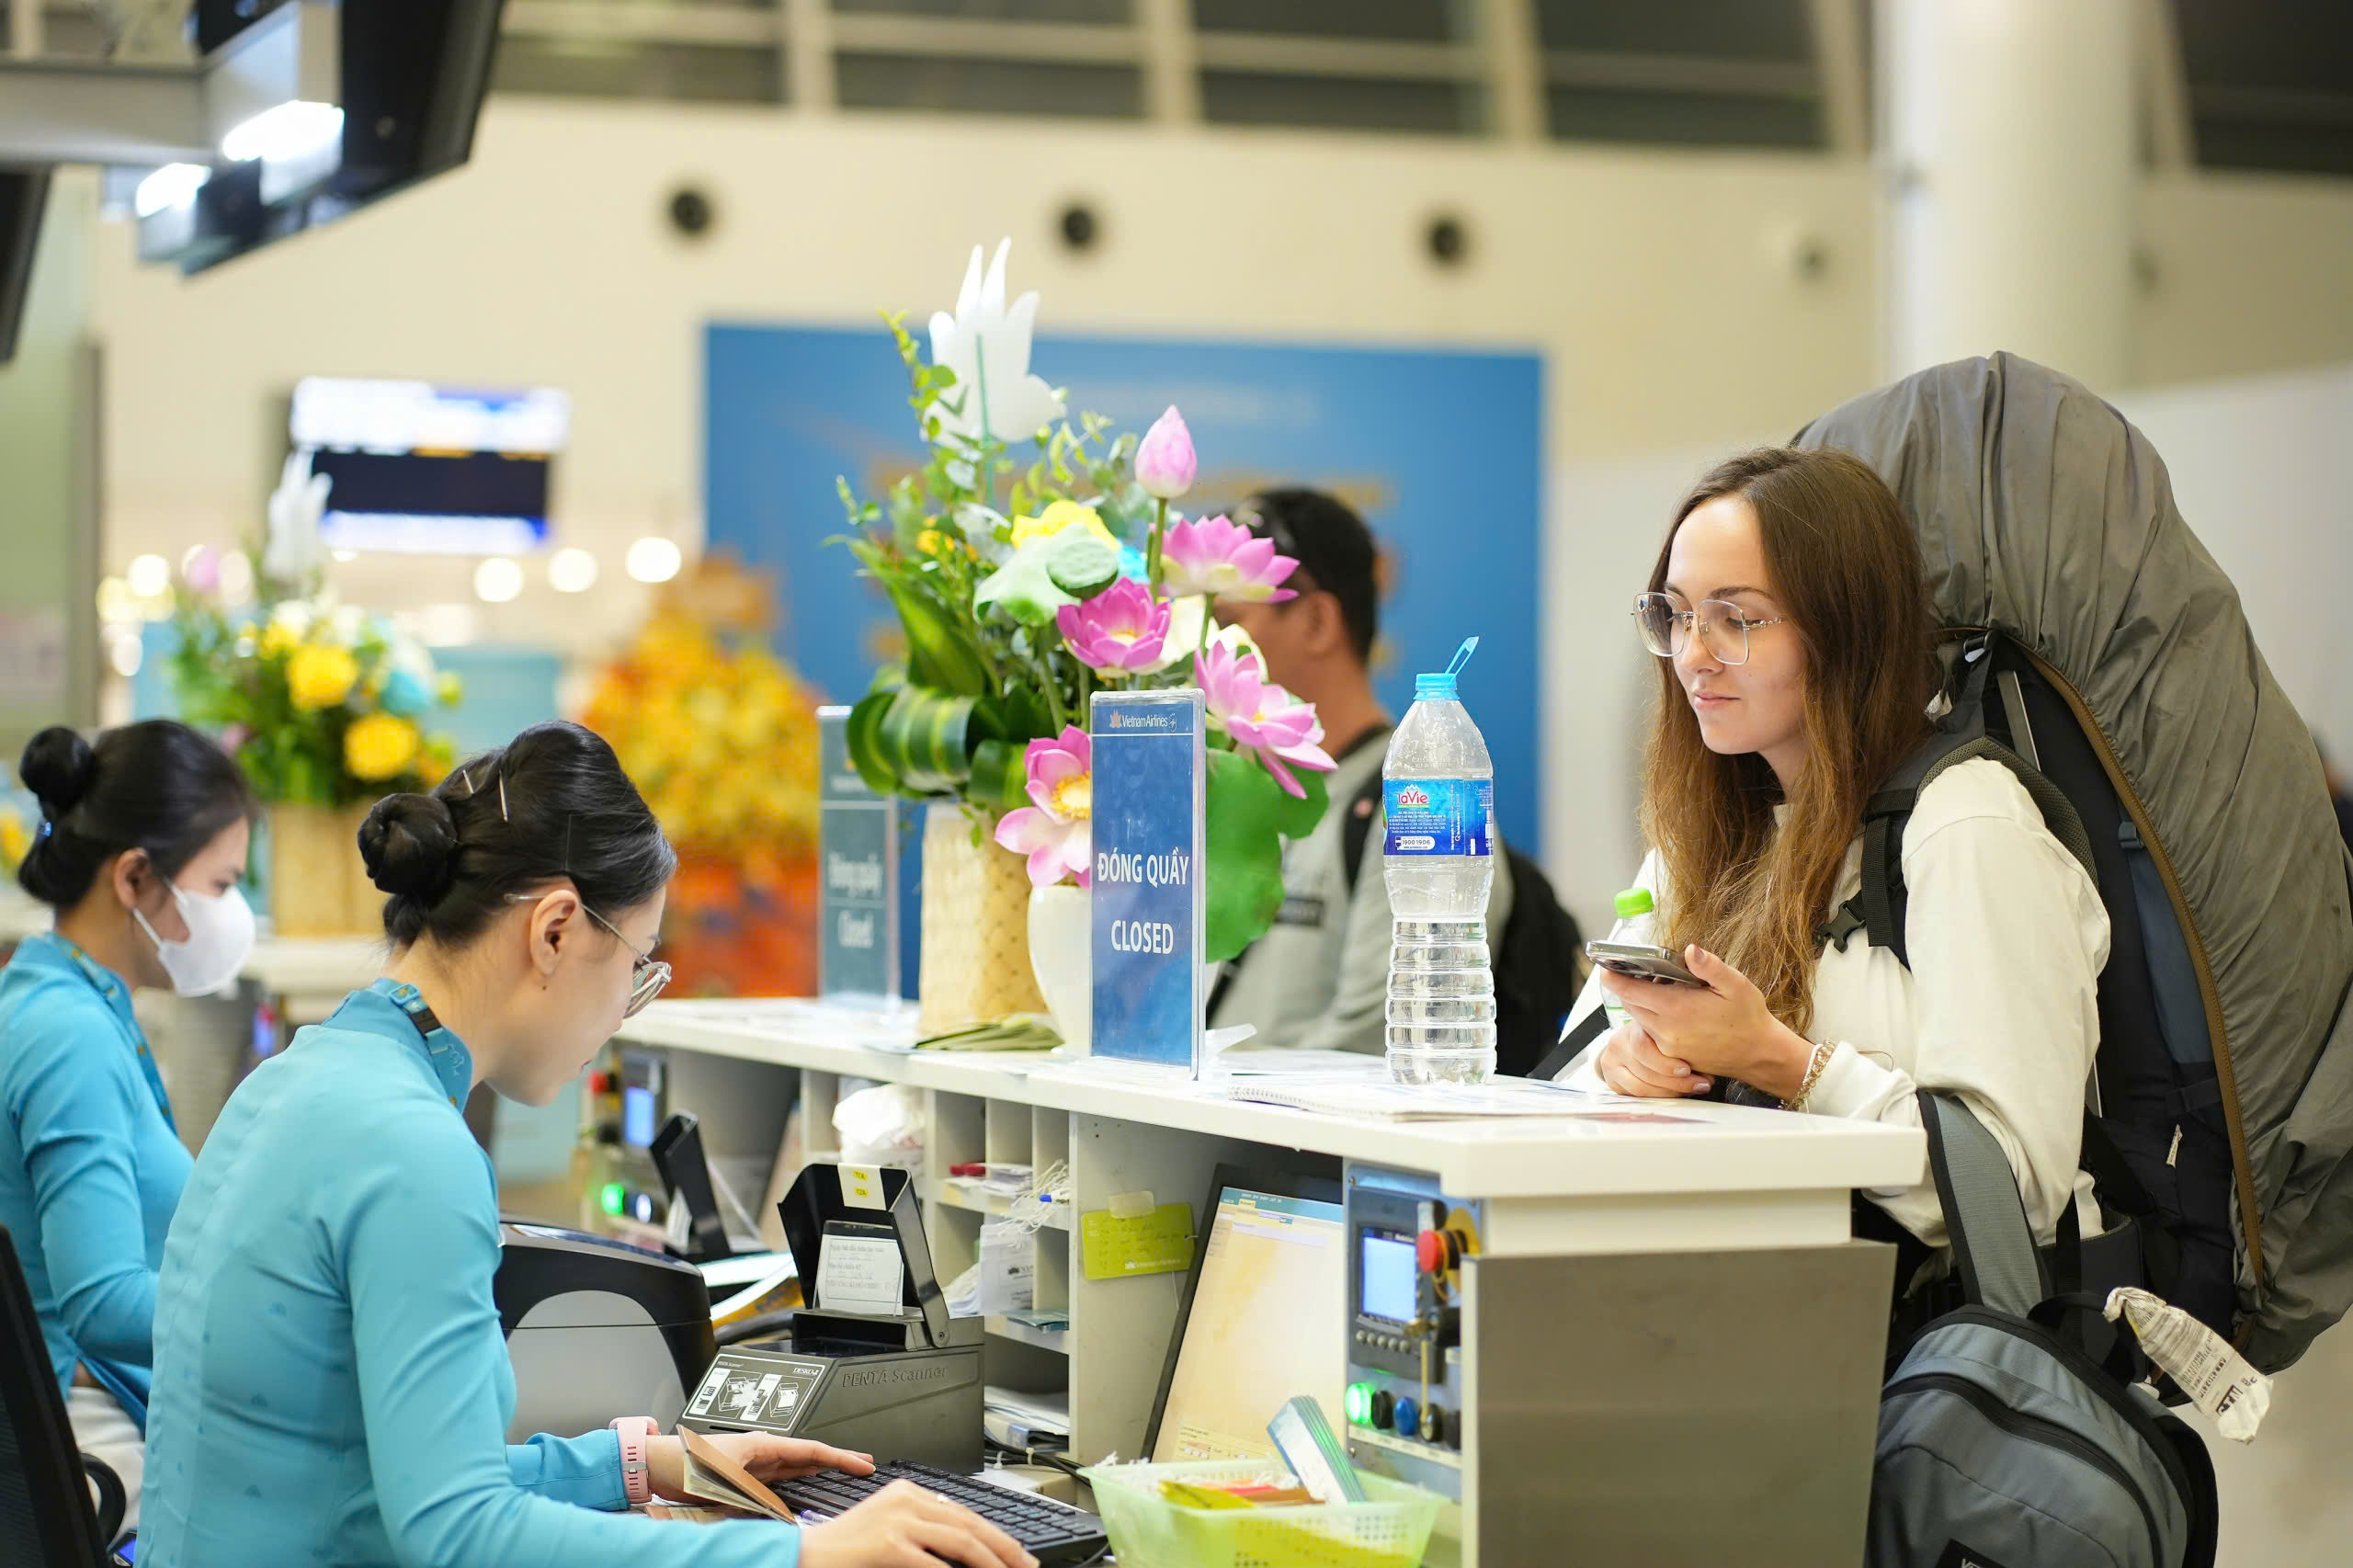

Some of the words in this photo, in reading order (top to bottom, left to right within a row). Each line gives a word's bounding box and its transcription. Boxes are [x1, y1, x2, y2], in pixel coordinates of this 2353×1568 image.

[1398, 790, 1428, 804] laVie
[1097, 846, 1142, 883] ĐÓNG
[1146, 846, 1190, 888] QUẦY
[1111, 920, 1174, 954] CLOSED
[842, 1369, 888, 1388] PENTA
[892, 1366, 947, 1383] Scanner
